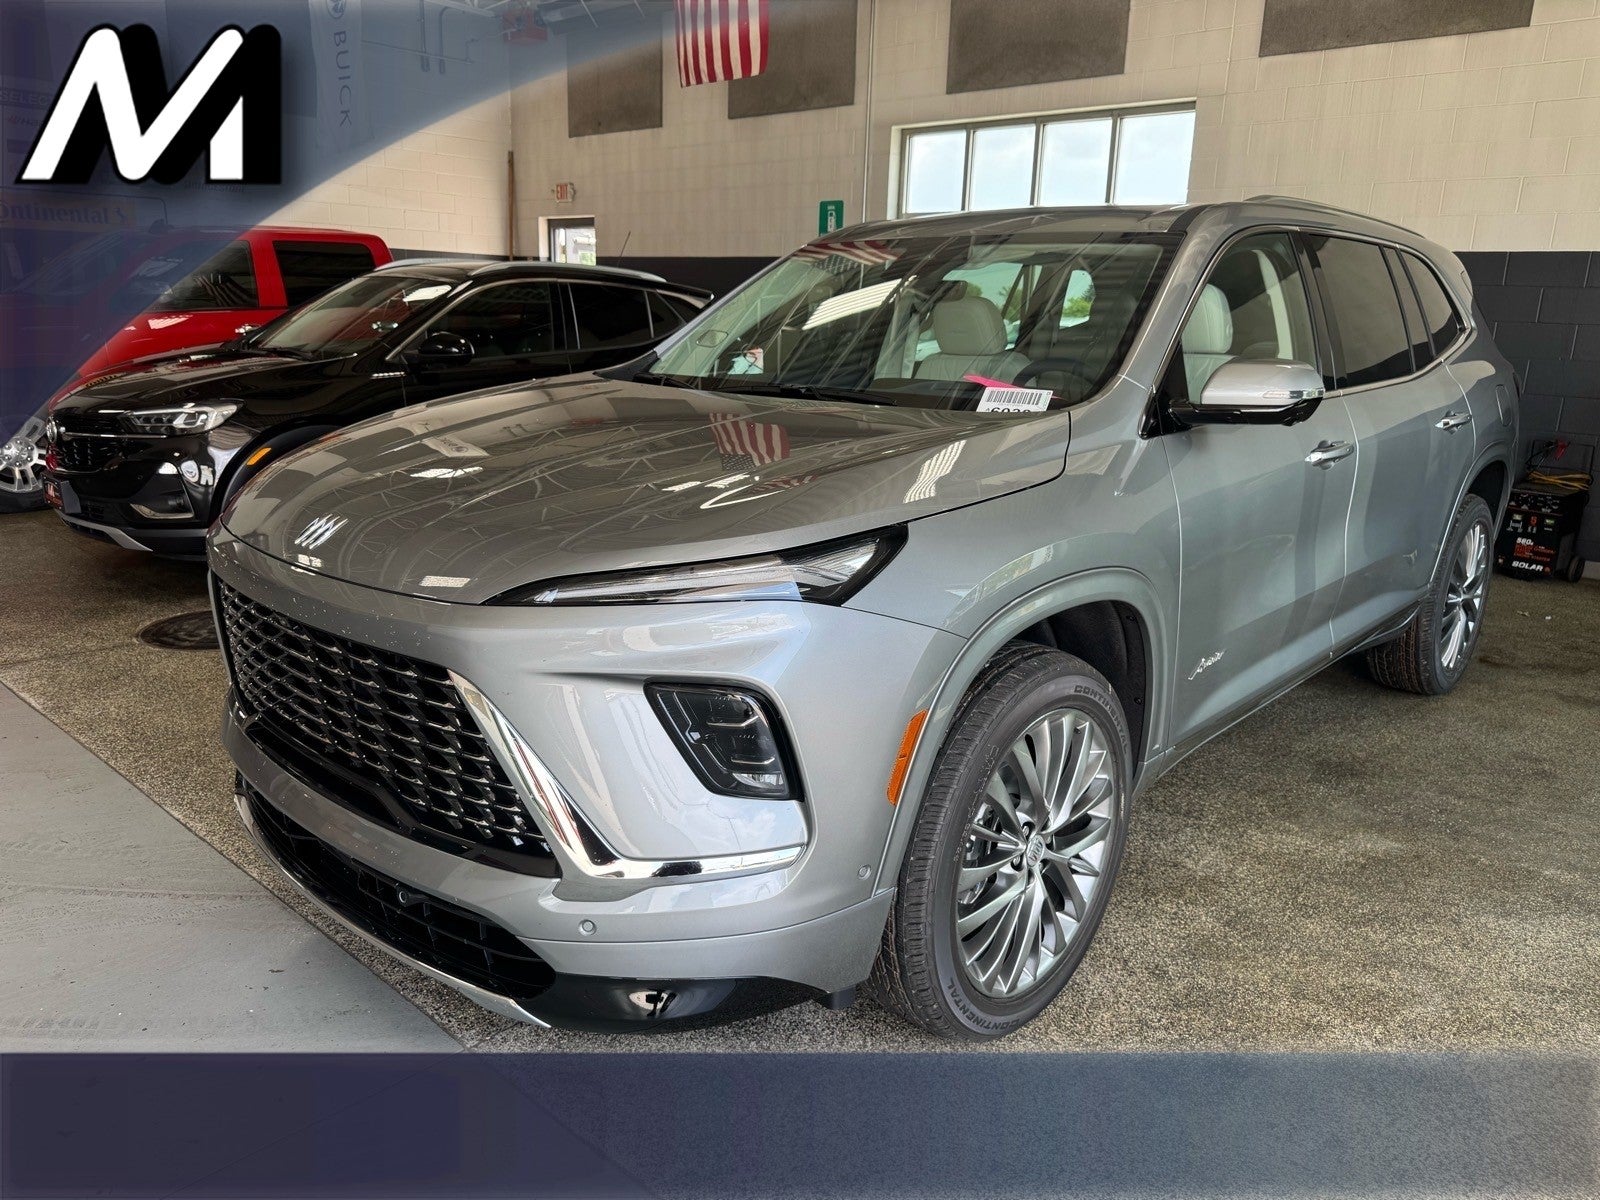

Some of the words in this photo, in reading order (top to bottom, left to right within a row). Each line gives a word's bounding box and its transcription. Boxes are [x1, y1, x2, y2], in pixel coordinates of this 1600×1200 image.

[333, 30, 353, 128] BUICK
[1, 88, 51, 105] SELEC
[0, 201, 109, 225] ontinental
[1511, 560, 1544, 572] SOLAR
[947, 977, 1021, 1030] CONTINENTAL
